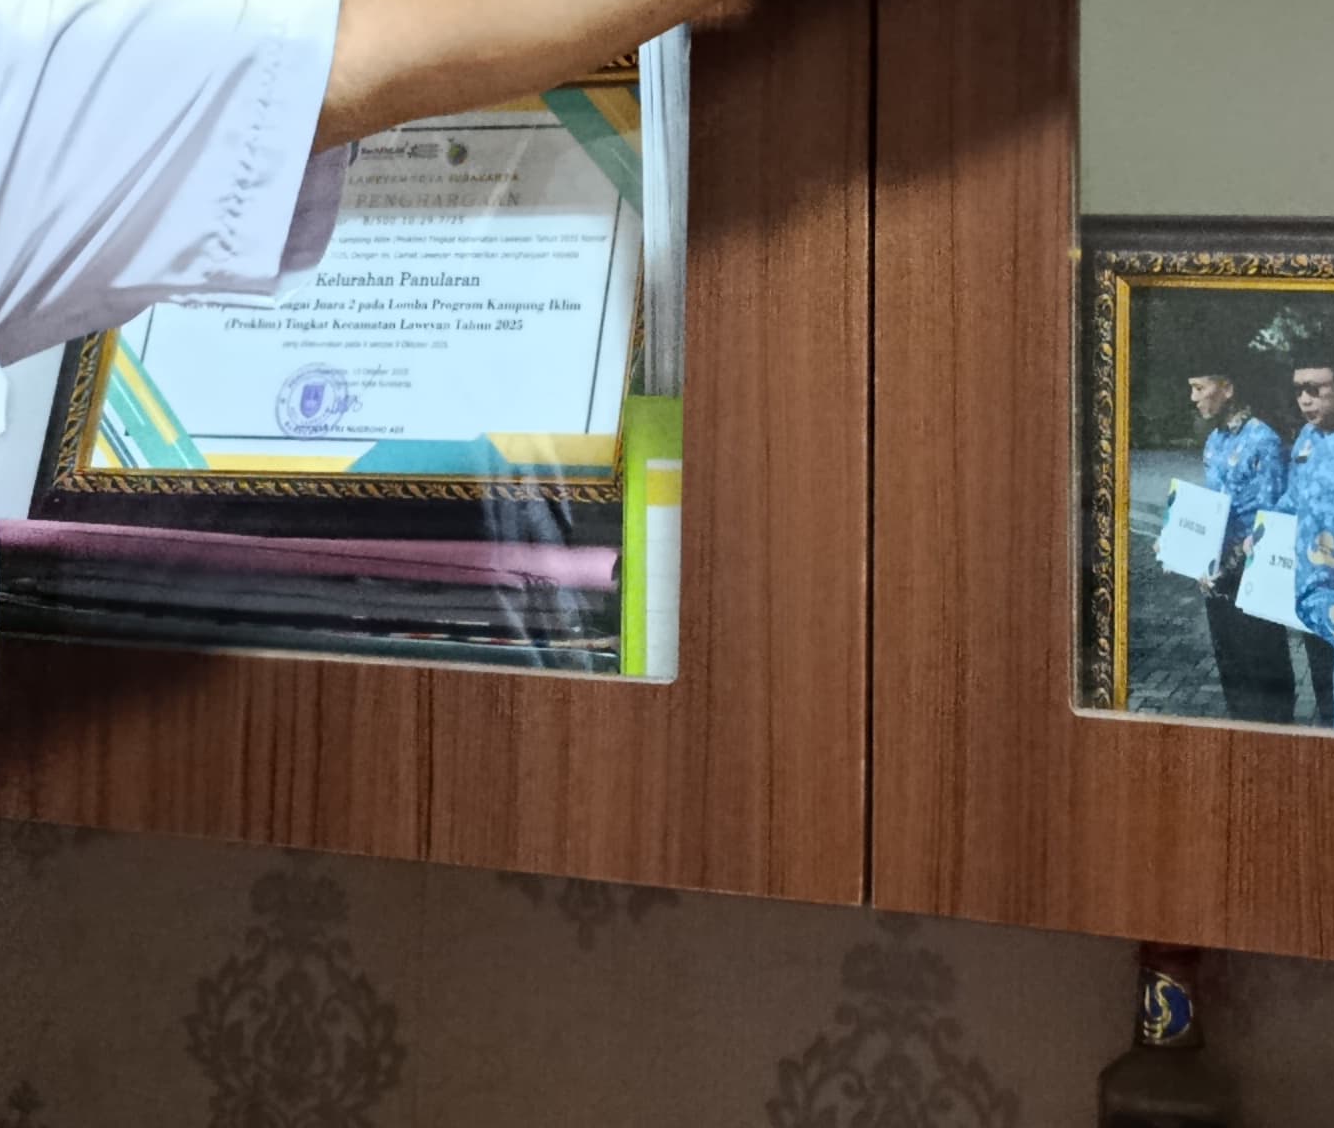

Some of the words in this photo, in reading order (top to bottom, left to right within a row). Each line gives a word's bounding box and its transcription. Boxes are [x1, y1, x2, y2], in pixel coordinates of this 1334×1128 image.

[315, 272, 394, 288] Kelurahan
[399, 272, 480, 288] Panularan
[313, 299, 345, 311] Juara
[348, 299, 355, 310] 2
[358, 299, 384, 313] pada
[388, 299, 428, 311] Lomba
[431, 299, 483, 313] Program
[487, 299, 545, 313] Kampung
[548, 299, 581, 311] Iklim
[224, 319, 282, 331] (Proklim)
[285, 319, 329, 331] Tingkat
[332, 319, 396, 331] Kecamatan
[495, 319, 523, 331] 2025
